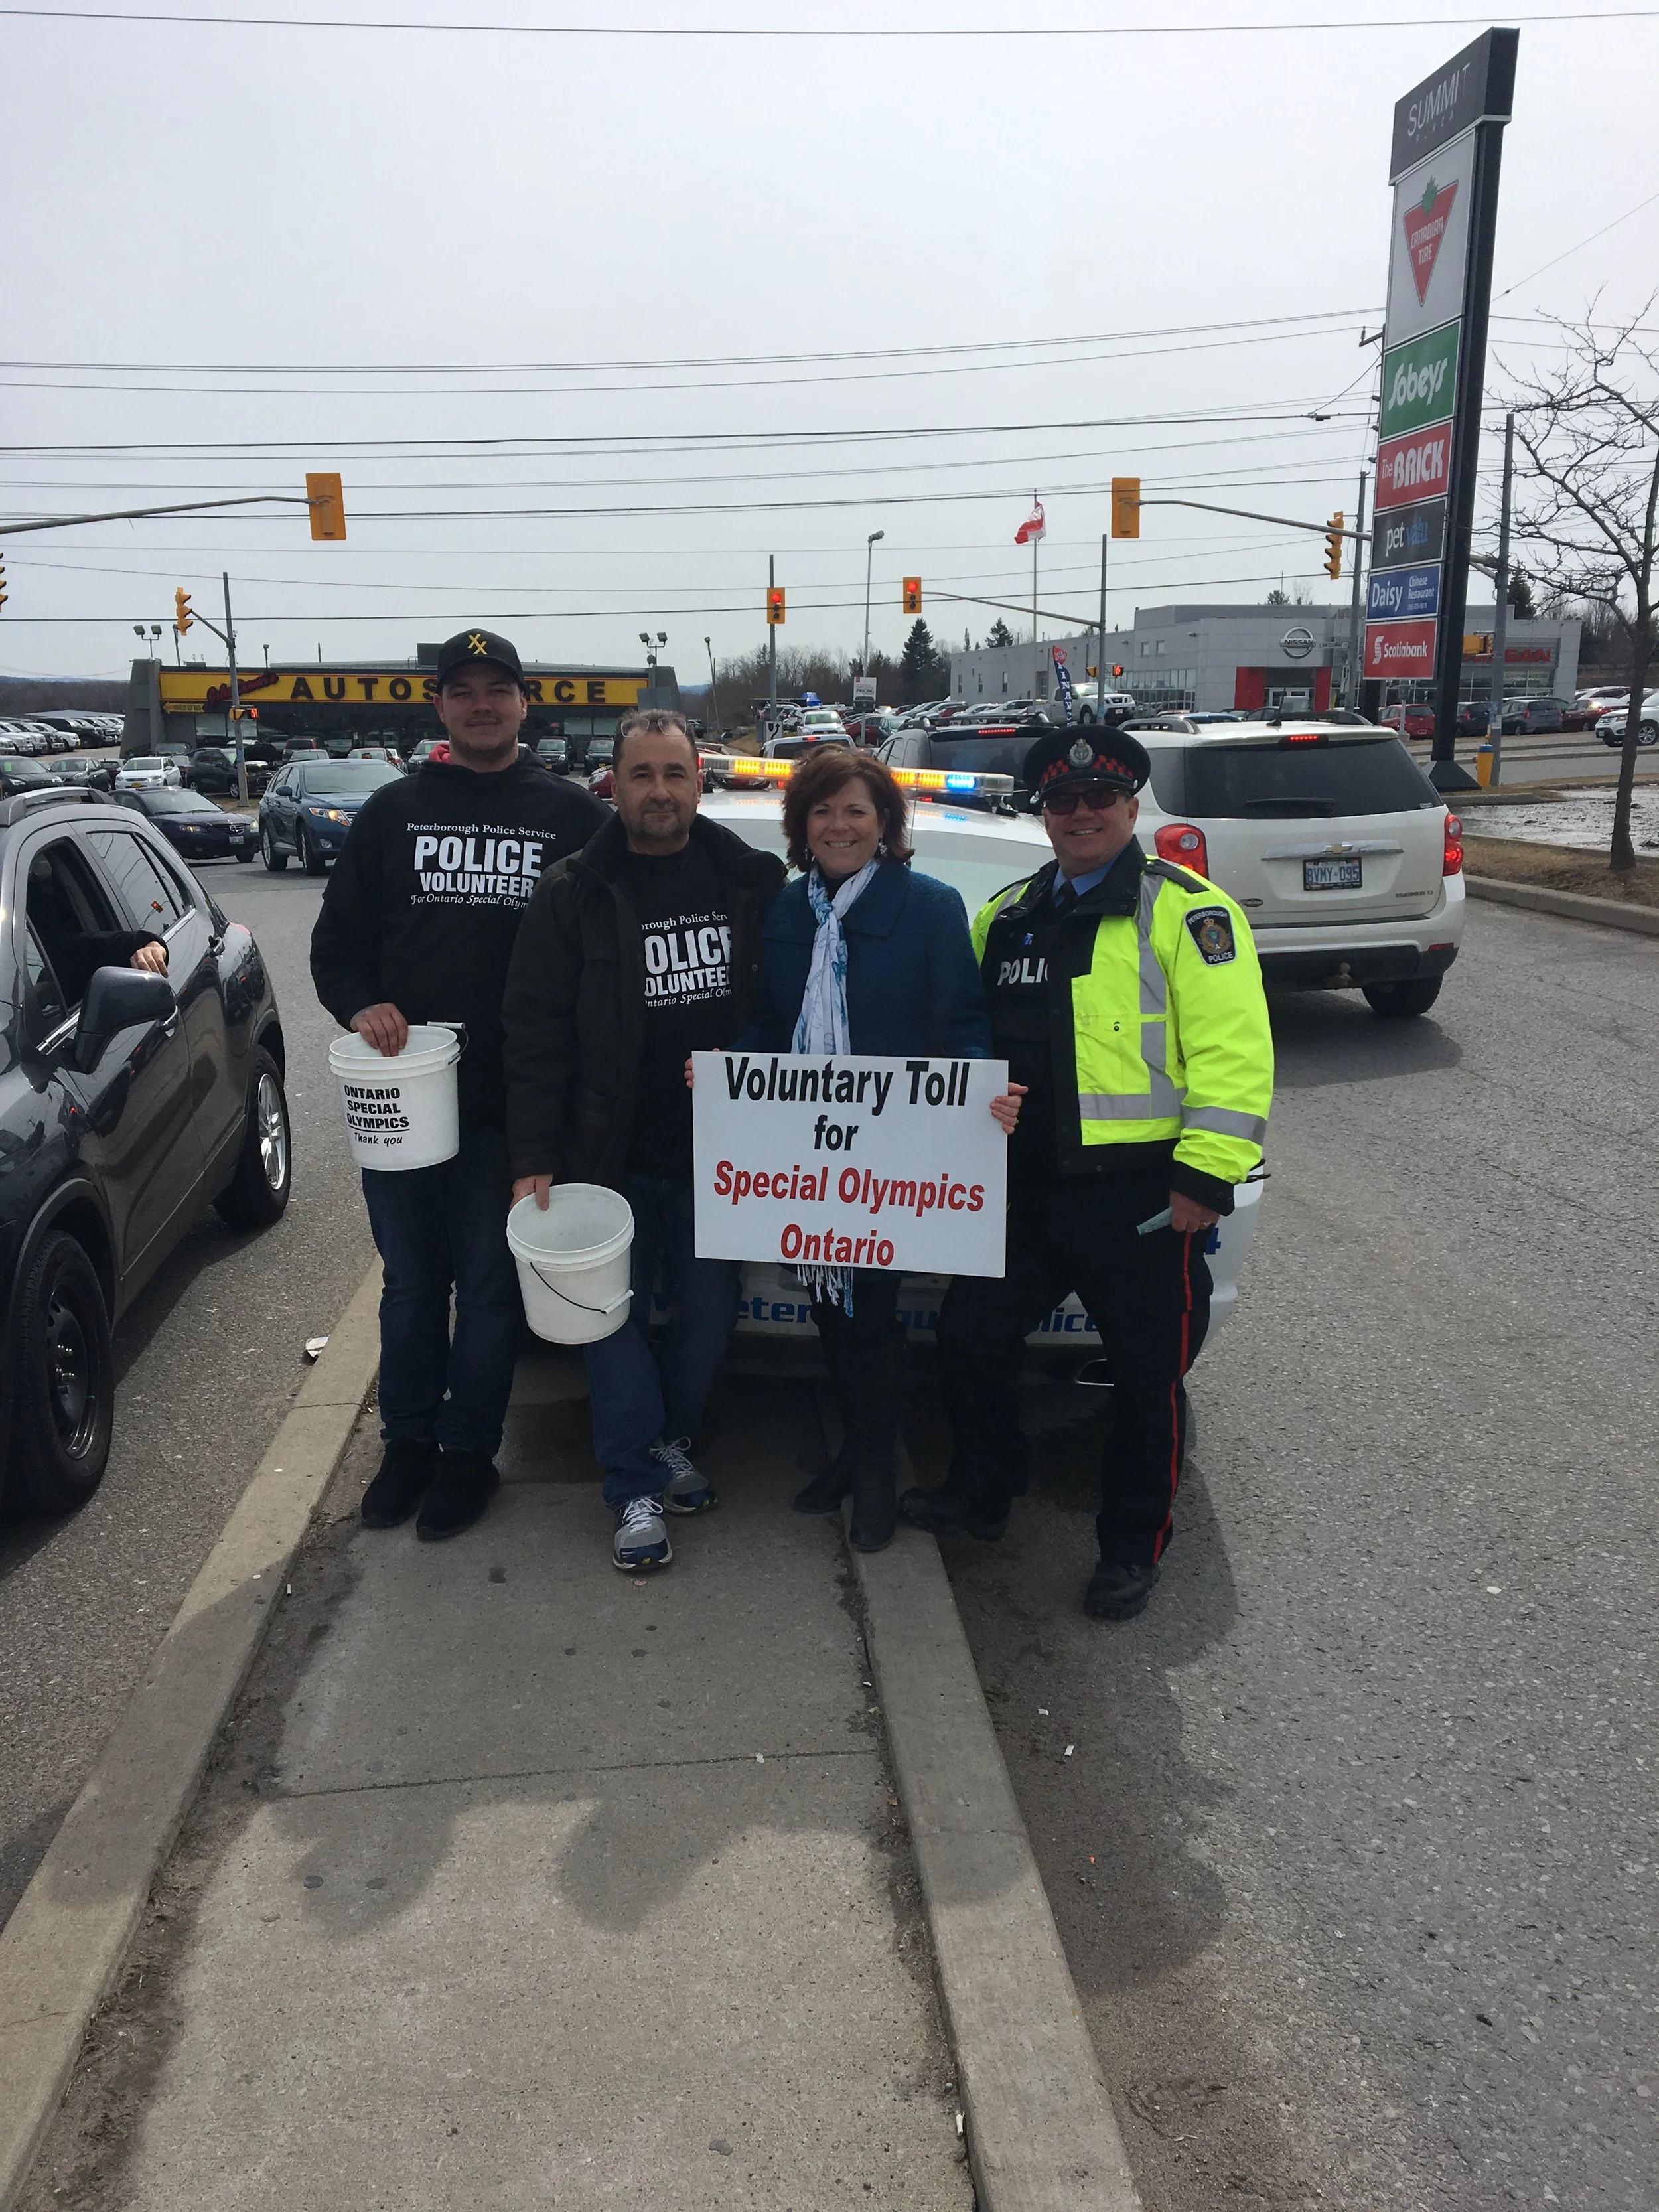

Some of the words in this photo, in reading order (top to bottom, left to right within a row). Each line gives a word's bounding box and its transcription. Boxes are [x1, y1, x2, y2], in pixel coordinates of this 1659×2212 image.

[1407, 62, 1471, 137] SUMMIT
[1411, 216, 1444, 249] CANADIAN
[1418, 243, 1433, 265] TIRE
[1388, 358, 1448, 411] Sobeys
[1382, 459, 1393, 479] The
[1393, 439, 1445, 489] BRICK
[1385, 522, 1405, 557] pet
[1408, 587, 1435, 599] Restaurant
[1409, 575, 1428, 587] Chinese
[1372, 580, 1403, 612] Daisy
[1384, 640, 1428, 658] Scotiabank
[291, 677, 606, 703] AUTOSRCE
[406, 822, 478, 834] Peterborough
[482, 824, 516, 834] Police
[518, 827, 557, 840] Service
[414, 836, 543, 878] POLICE
[419, 872, 534, 898] VOLUNTEER
[1340, 865, 1360, 881] 095
[410, 895, 426, 905] For
[426, 893, 464, 904] Ontario
[465, 895, 500, 906] Special
[679, 913, 710, 925] Police
[1187, 910, 1228, 924] PETERBOROUGH
[1208, 951, 1234, 963] POLICE
[644, 966, 731, 997] OLUNTEE
[997, 958, 1048, 986] POLI
[645, 996, 677, 1007] ntario
[680, 988, 713, 1005] Special
[344, 1084, 401, 1100] ONTARIO
[725, 1057, 894, 1116] Voluntary
[906, 1060, 970, 1106] Toll
[347, 1100, 401, 1114] SPECIAL
[346, 1113, 409, 1129] OLYMPICS
[814, 1114, 859, 1151] for
[354, 1132, 379, 1145] Thank
[383, 1136, 403, 1147] you
[714, 1160, 829, 1205] Special
[838, 1167, 985, 1217] Olympics
[780, 1224, 895, 1266] Ontario
